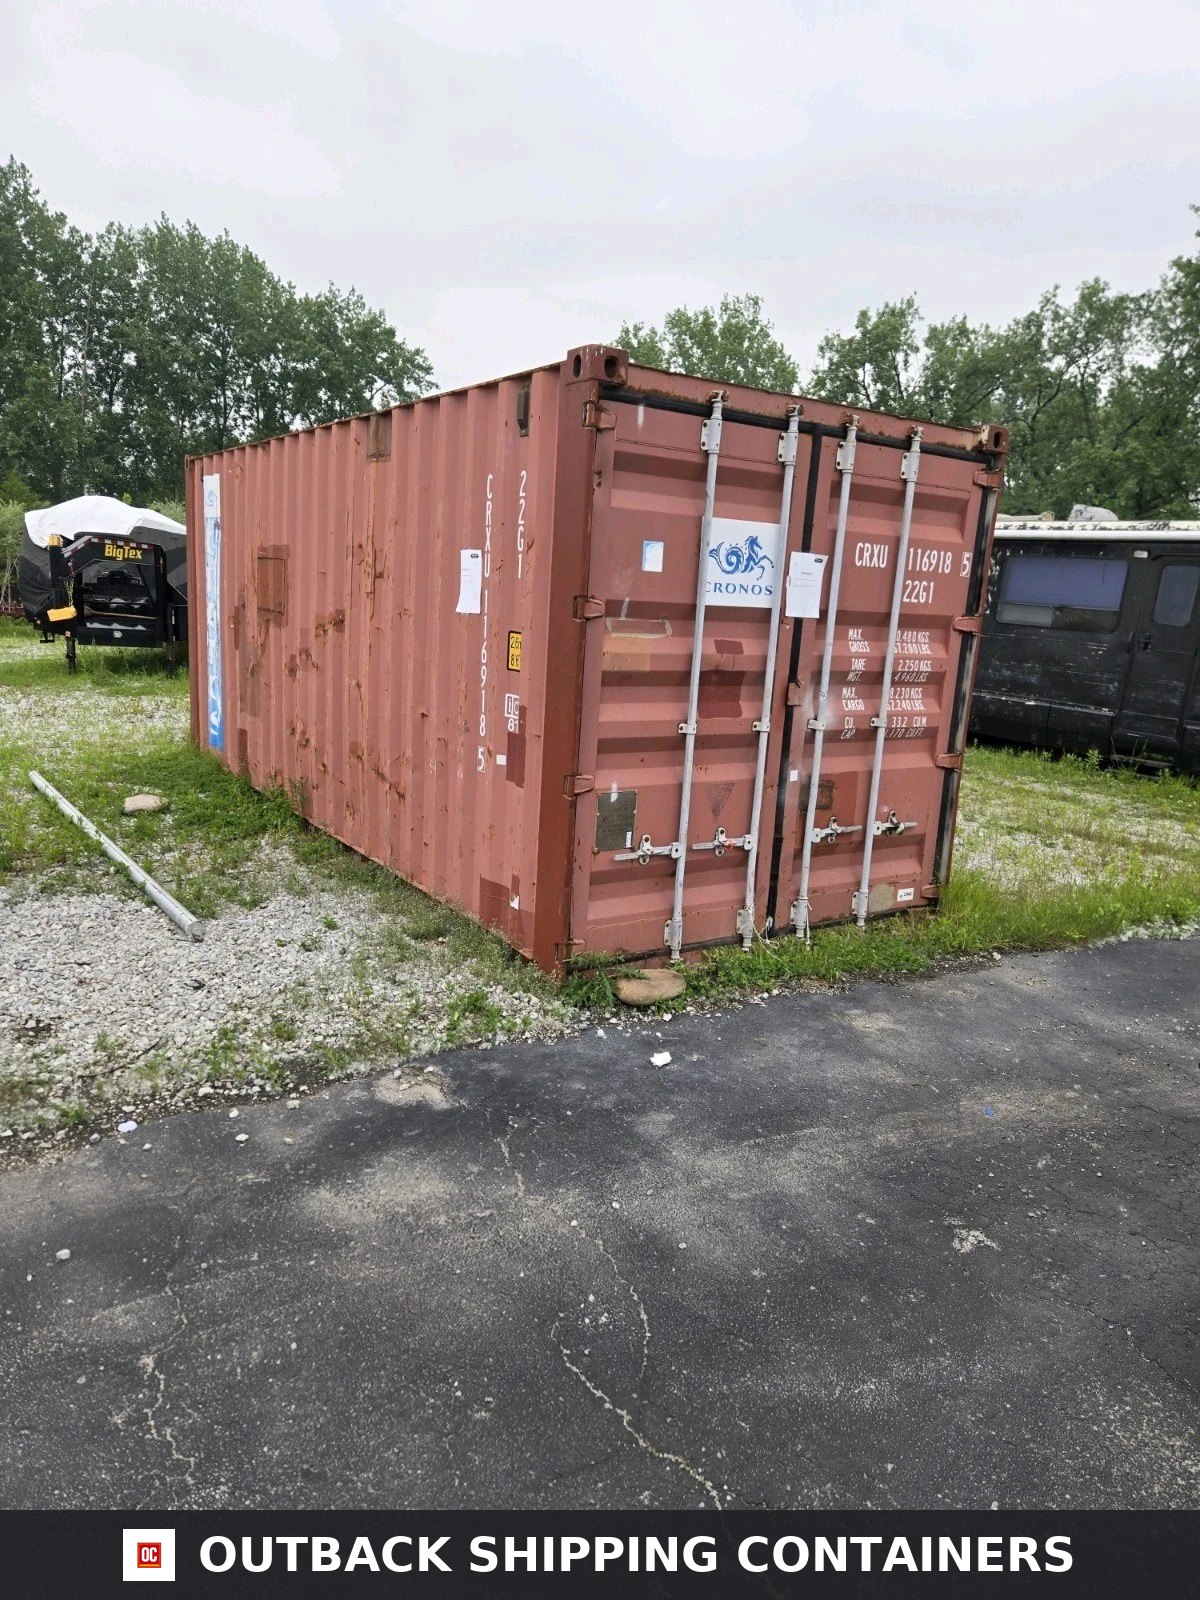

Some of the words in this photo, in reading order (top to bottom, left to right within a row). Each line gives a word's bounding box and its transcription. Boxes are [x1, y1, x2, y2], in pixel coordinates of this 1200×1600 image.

[484, 474, 494, 578] CRXU
[518, 470, 527, 579] 22G1
[104, 544, 143, 560] BigTex
[855, 541, 889, 568] CRXU
[908, 547, 953, 574] 116918
[961, 553, 971, 576] 5
[902, 580, 935, 604] 22G1
[848, 628, 864, 640] MAX.
[848, 641, 870, 652] GROSS
[918, 644, 932, 655] LBS.
[480, 590, 488, 737] 116918
[851, 658, 866, 670] TARE
[898, 660, 918, 672] 2.250
[842, 687, 858, 698] MAX.
[842, 699, 865, 710] CARGO
[844, 716, 856, 728] CU.
[892, 716, 908, 728] 33.2
[840, 730, 856, 740] CAP.
[478, 747, 485, 771] 5
